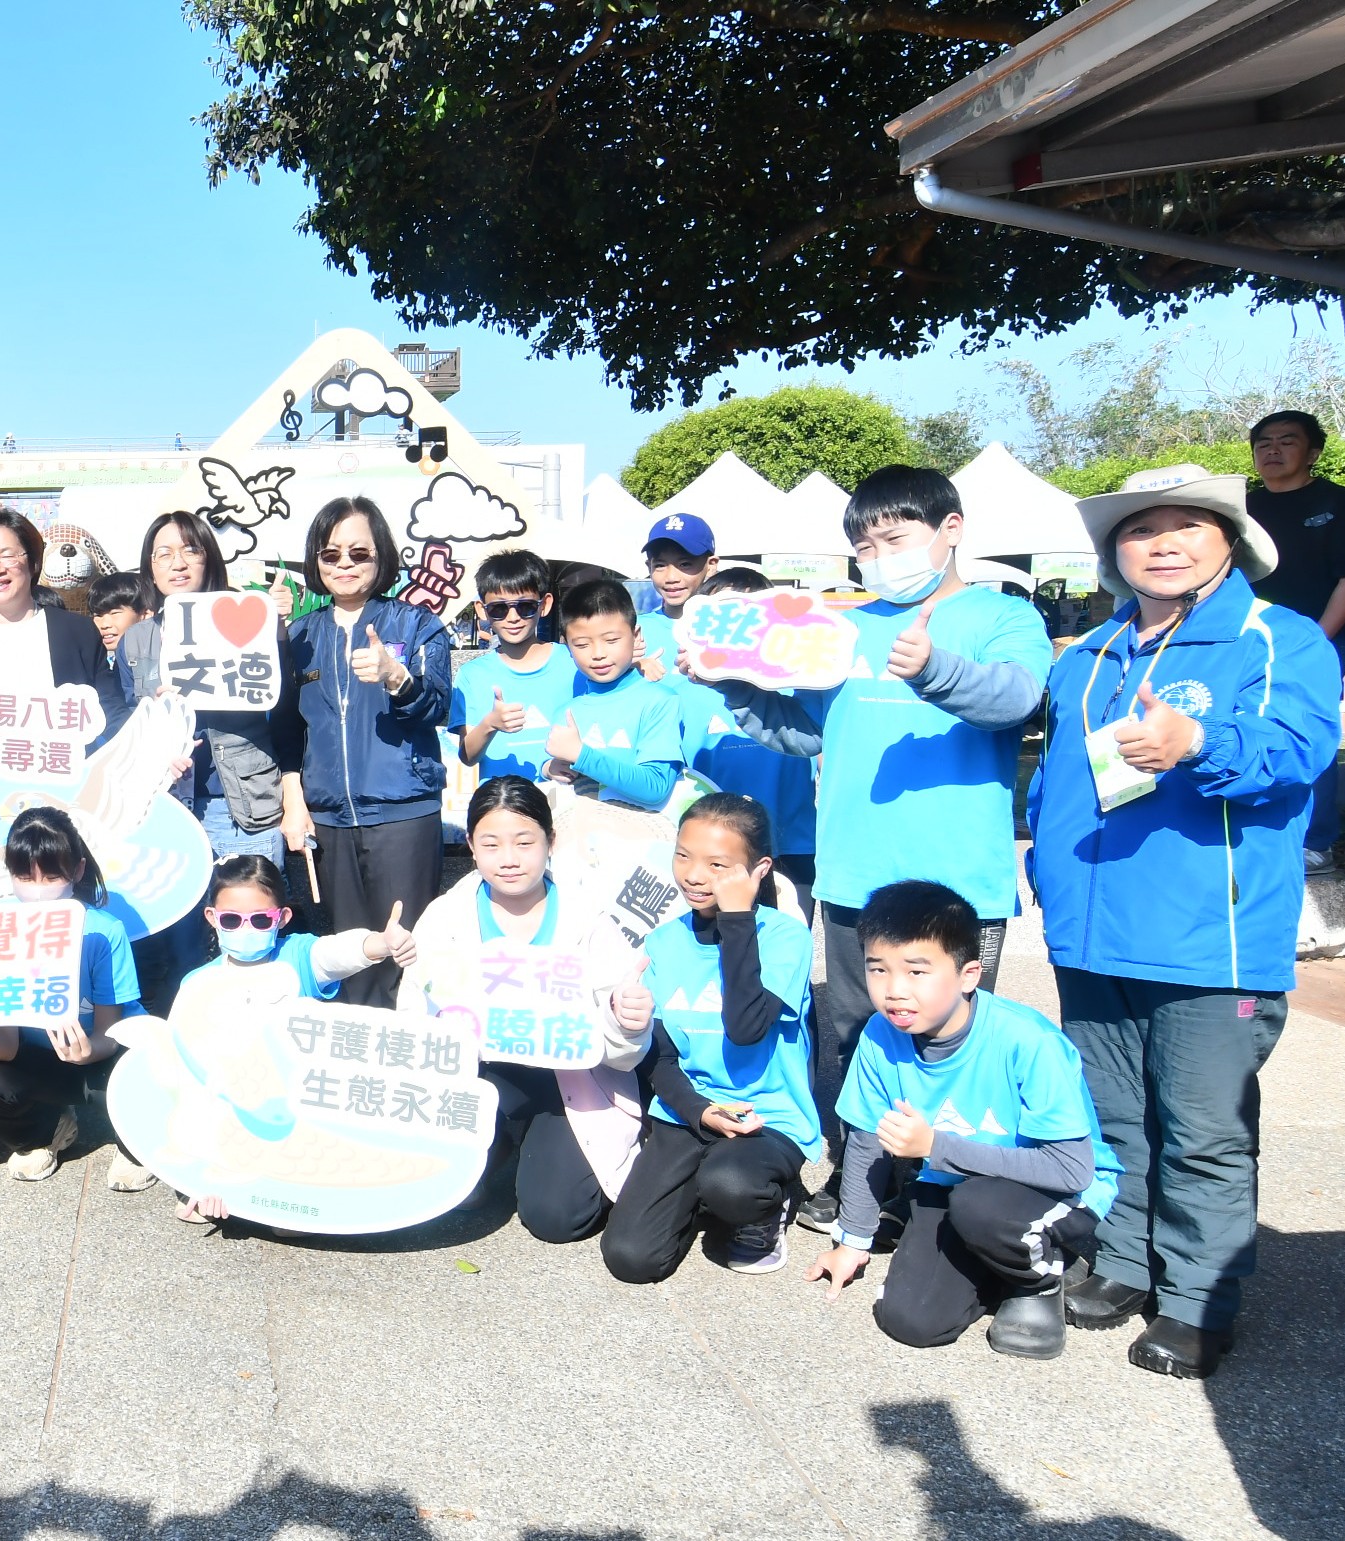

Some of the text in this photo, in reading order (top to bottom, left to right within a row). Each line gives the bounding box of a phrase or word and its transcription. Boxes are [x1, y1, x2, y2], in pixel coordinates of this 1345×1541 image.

[665, 515, 684, 531] LA
[179, 601, 198, 646] I
[691, 602, 840, 675] 揪咪
[168, 651, 273, 705] 文德
[479, 950, 584, 1001] 文德
[286, 1013, 462, 1076] 守護棲地
[485, 1005, 594, 1061] 驕傲
[299, 1068, 481, 1134] 生態永續
